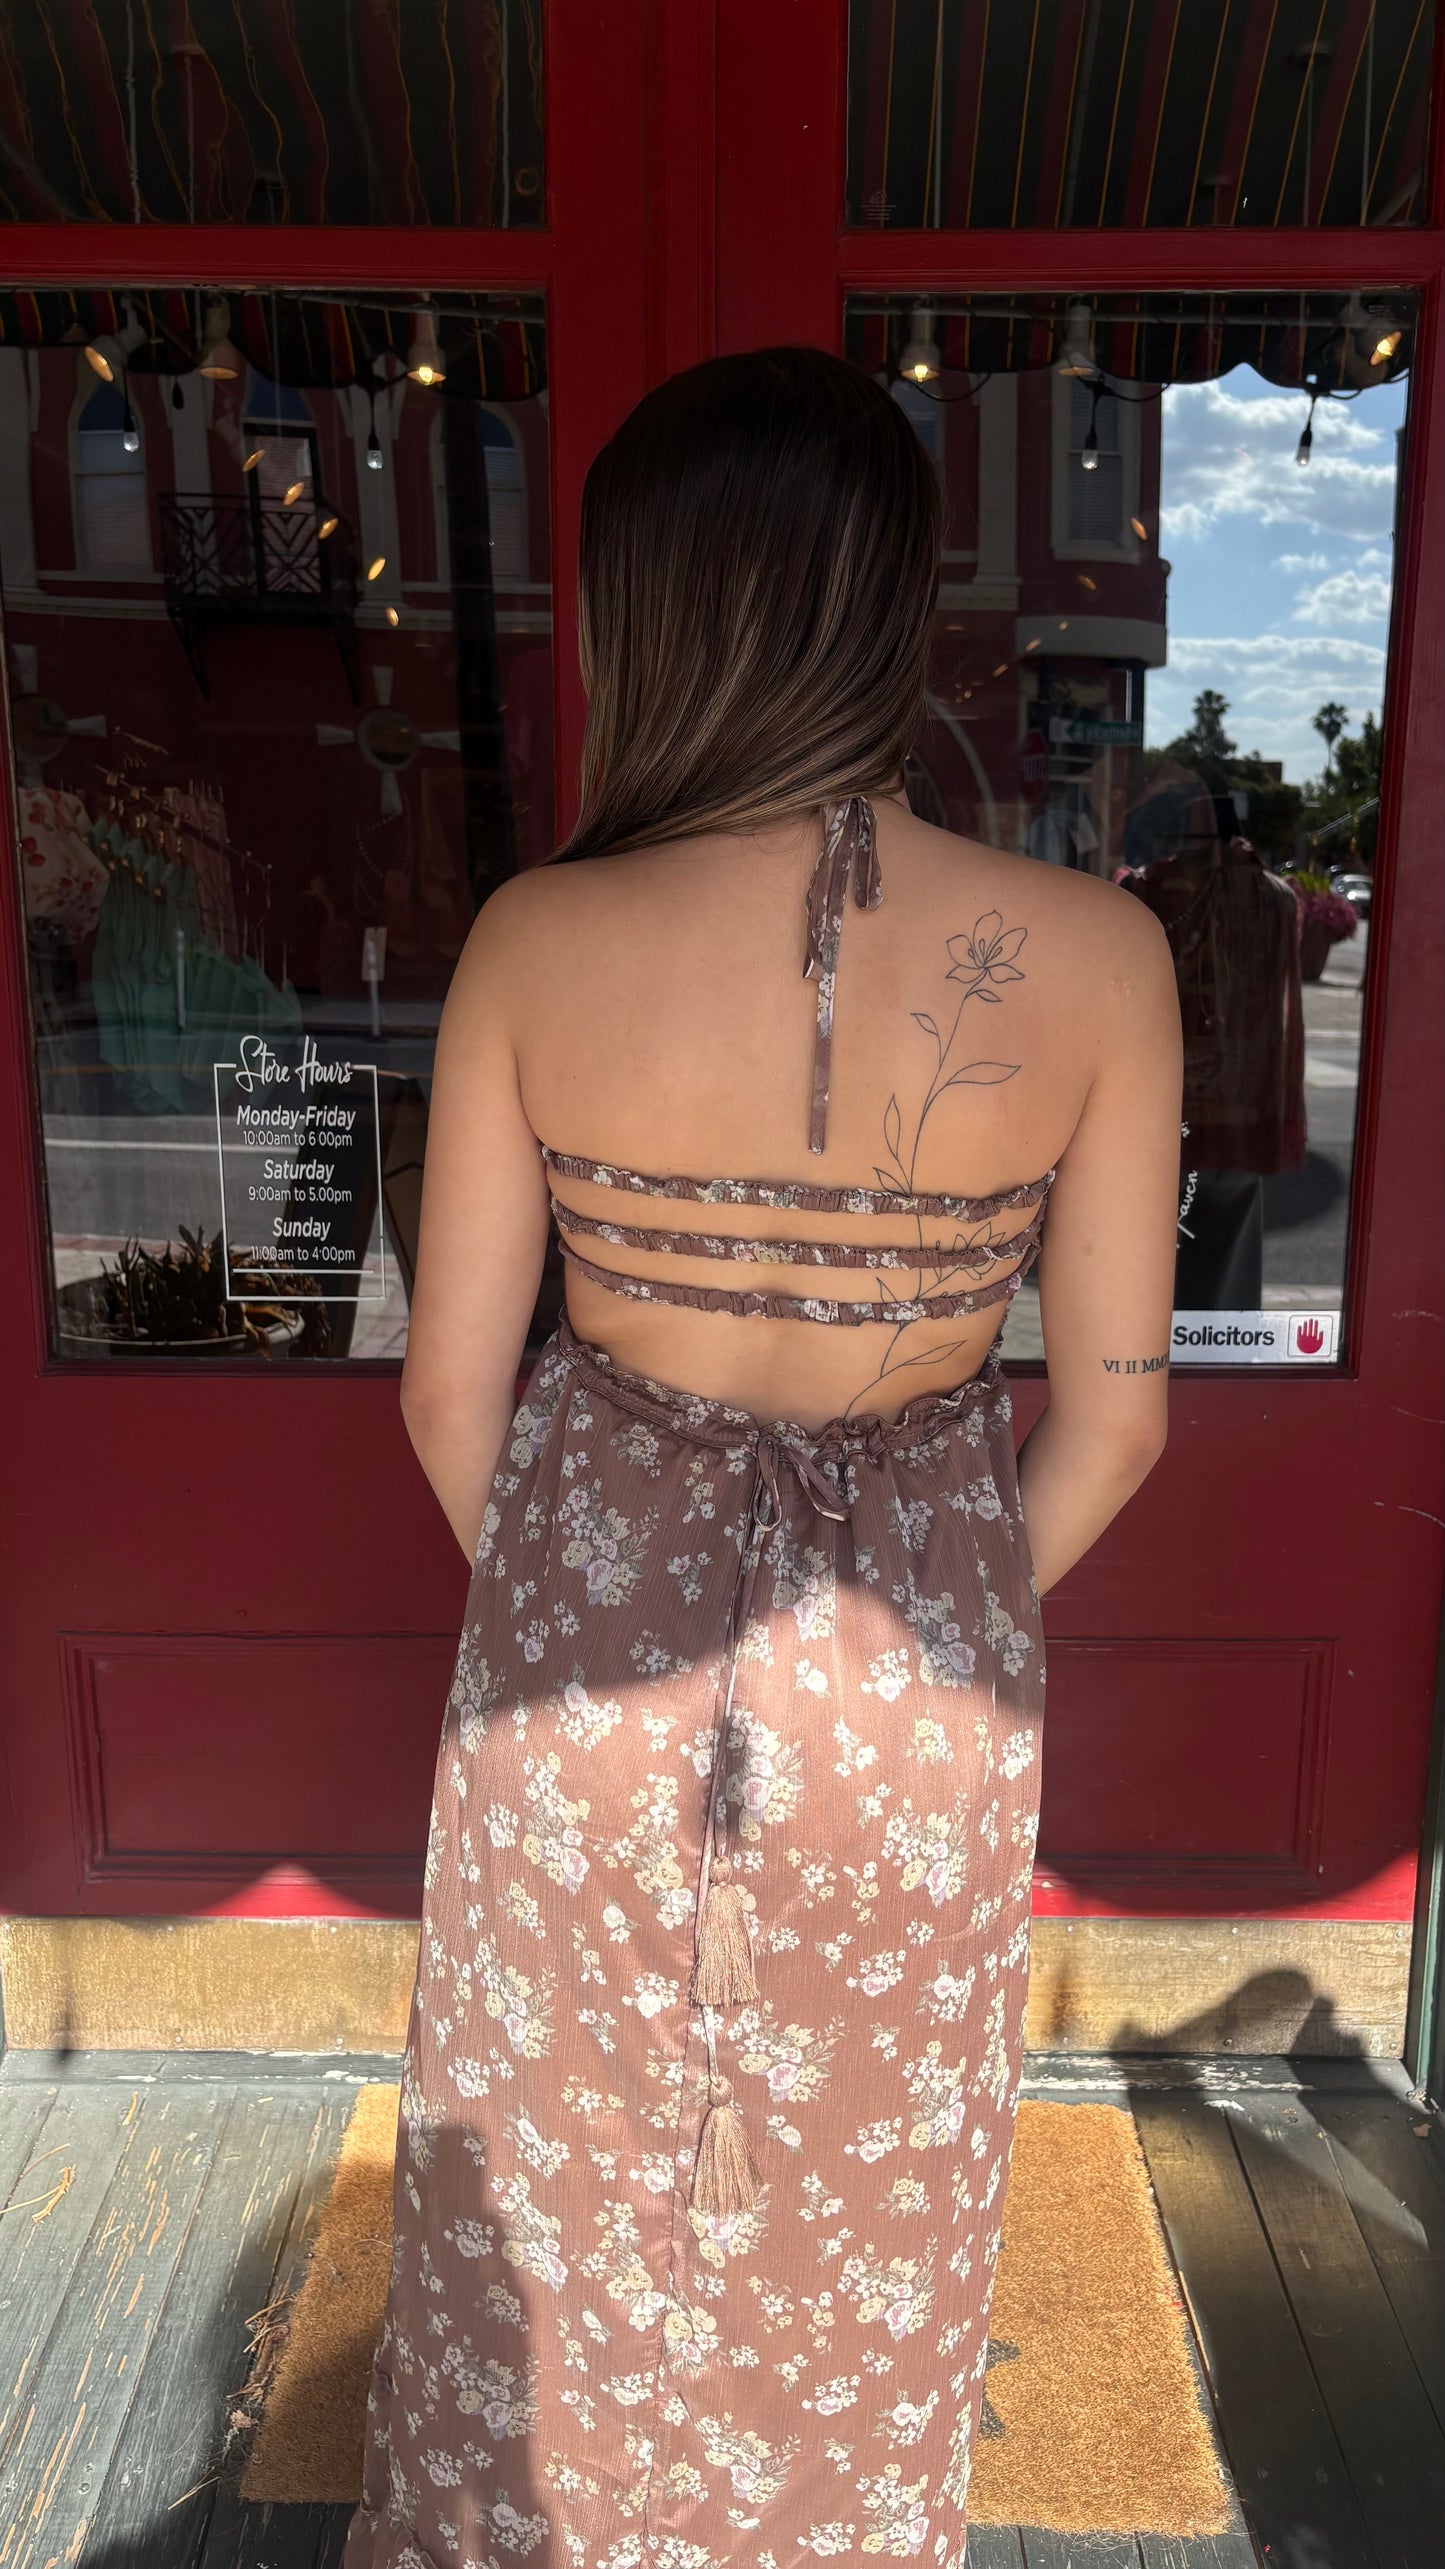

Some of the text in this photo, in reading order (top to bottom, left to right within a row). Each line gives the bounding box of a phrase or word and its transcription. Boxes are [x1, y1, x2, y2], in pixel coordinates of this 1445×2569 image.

[235, 1034, 354, 1094] Store Hours
[236, 1104, 357, 1131] Monday-Friday
[243, 1130, 291, 1146] 10:00am
[294, 1131, 306, 1146] to
[263, 1158, 335, 1184] Saturday
[248, 1186, 292, 1201] 9:00am
[294, 1187, 306, 1202] to
[272, 1216, 332, 1242] Sunday
[251, 1245, 295, 1261] 11:00am
[297, 1246, 309, 1261] to
[1172, 1325, 1275, 1347] Solicitors
[1102, 1359, 1121, 1374] VI
[1125, 1360, 1138, 1374] II
